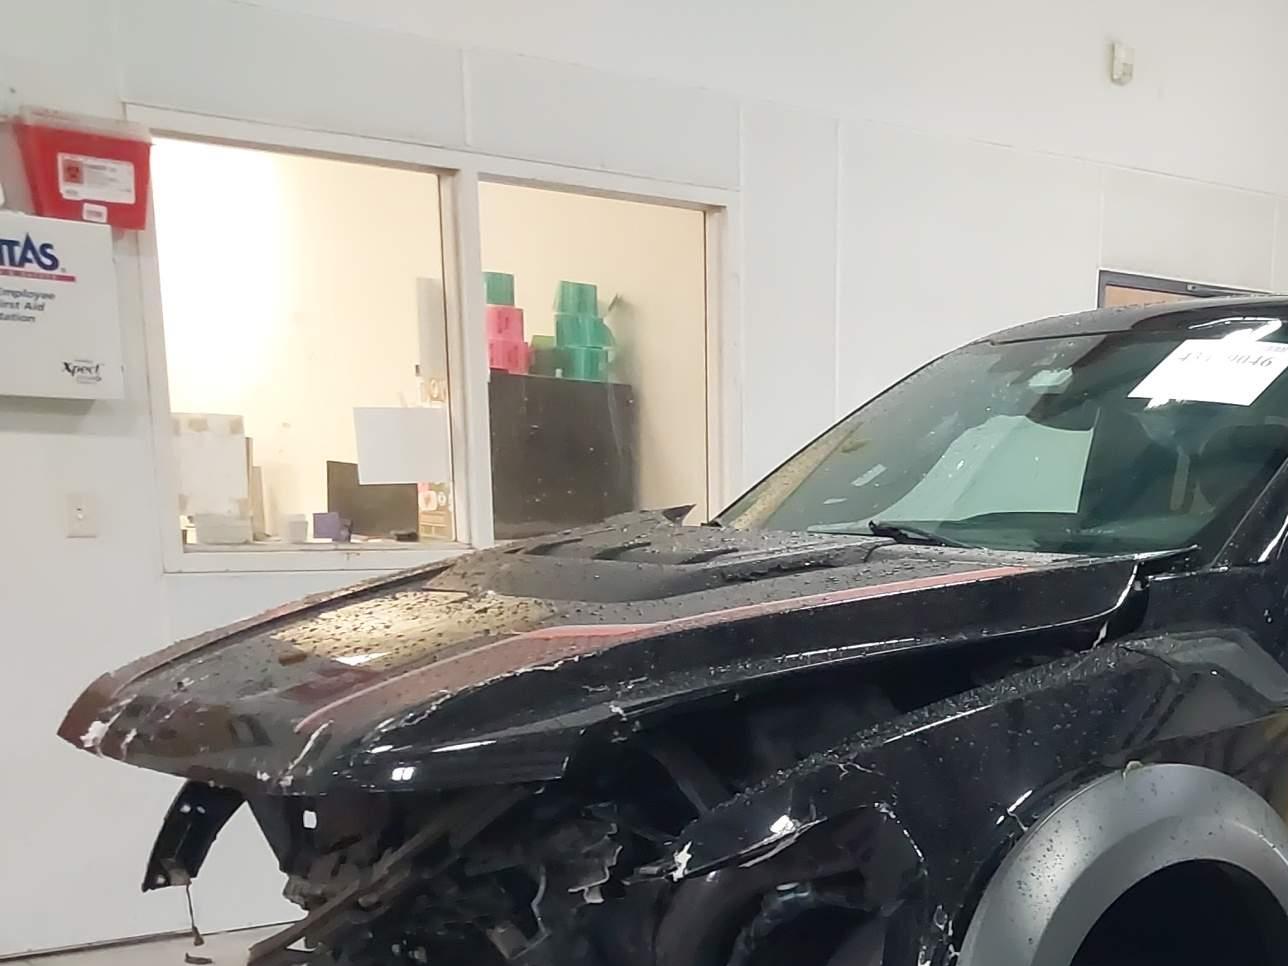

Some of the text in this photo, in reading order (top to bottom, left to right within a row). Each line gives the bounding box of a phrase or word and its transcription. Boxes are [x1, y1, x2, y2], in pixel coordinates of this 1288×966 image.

[24, 301, 45, 311] Aid
[0, 310, 36, 322] tation
[62, 361, 100, 376] Xpect
